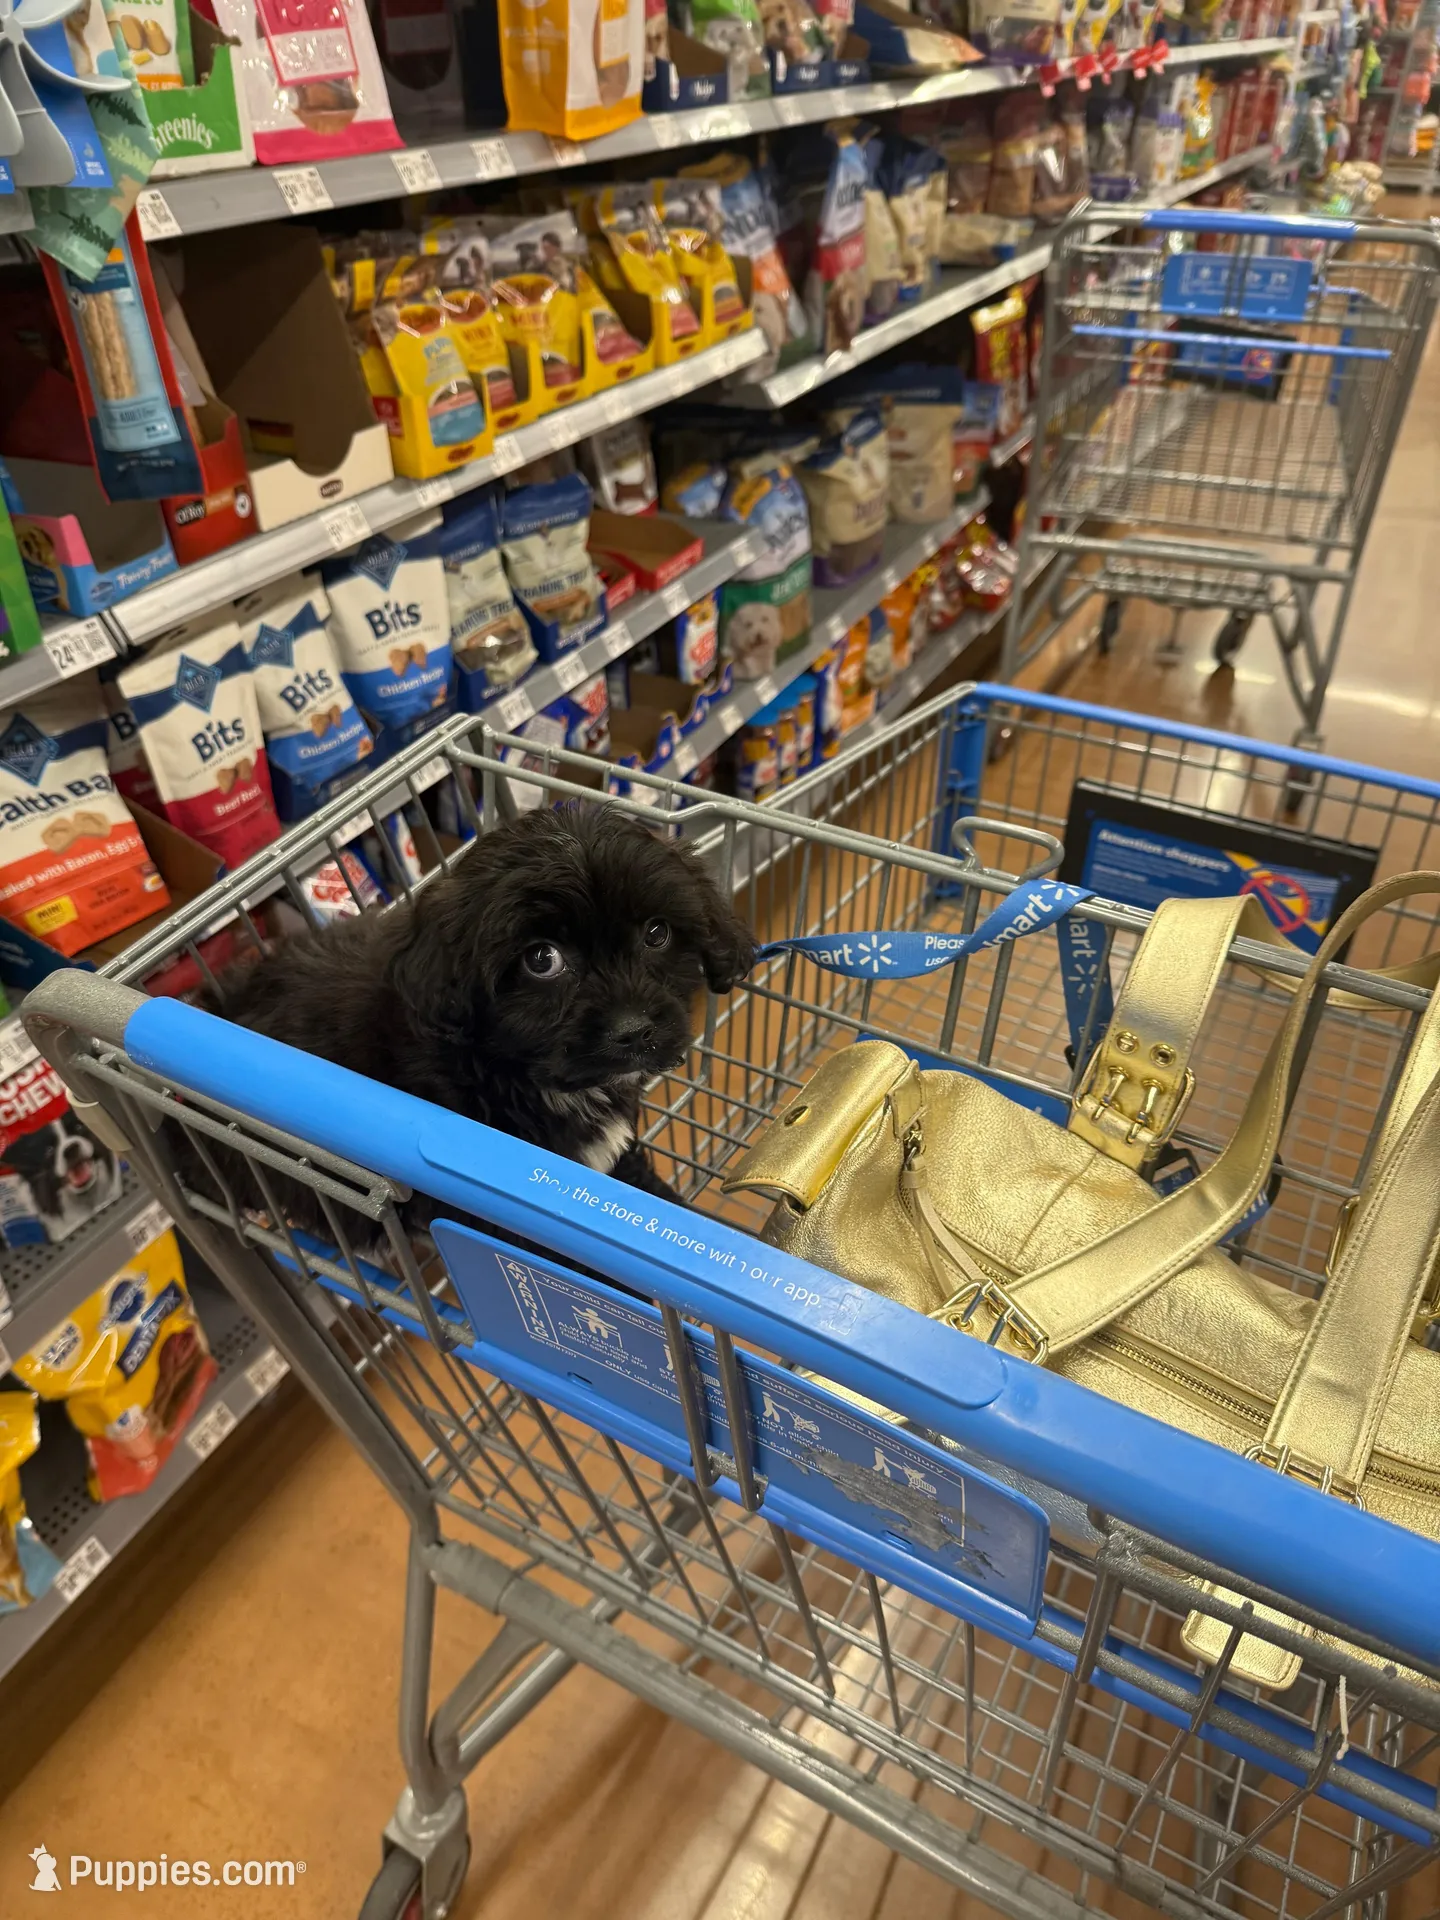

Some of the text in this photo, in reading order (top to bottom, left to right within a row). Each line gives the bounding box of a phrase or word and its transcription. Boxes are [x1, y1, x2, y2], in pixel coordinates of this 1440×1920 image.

[365, 600, 422, 640] Bits
[279, 668, 333, 713] Bits
[191, 718, 246, 763] Bits
[214, 794, 242, 818] Beef
[35, 862, 67, 884] with
[572, 1184, 601, 1209] the
[600, 1199, 644, 1228] store
[644, 1217, 659, 1234] &
[659, 1225, 707, 1256] more
[783, 1280, 822, 1309] app.
[508, 1268, 550, 1339] WARNING
[557, 1321, 600, 1343] ALWAYS
[631, 1354, 645, 1364] up
[558, 1325, 580, 1338] child
[581, 1335, 592, 1344] in
[593, 1339, 610, 1351] cart
[630, 1358, 649, 1370] and
[560, 1331, 588, 1348] fasten
[542, 1276, 570, 1293] Your
[572, 1288, 601, 1306] child
[603, 1303, 626, 1318] can
[627, 1313, 647, 1328] fall
[762, 1376, 801, 1400] suffer
[803, 1398, 812, 1406] a
[814, 1401, 864, 1432] serious
[867, 1429, 901, 1451] head
[903, 1449, 948, 1477] injury.
[604, 1359, 632, 1376] ONLY
[633, 1374, 651, 1387] use
[651, 1382, 670, 1395] cart
[769, 1440, 793, 1457] 6-48
[757, 1420, 777, 1434] ride
[761, 1415, 785, 1433] NOT
[788, 1431, 814, 1446] allow
